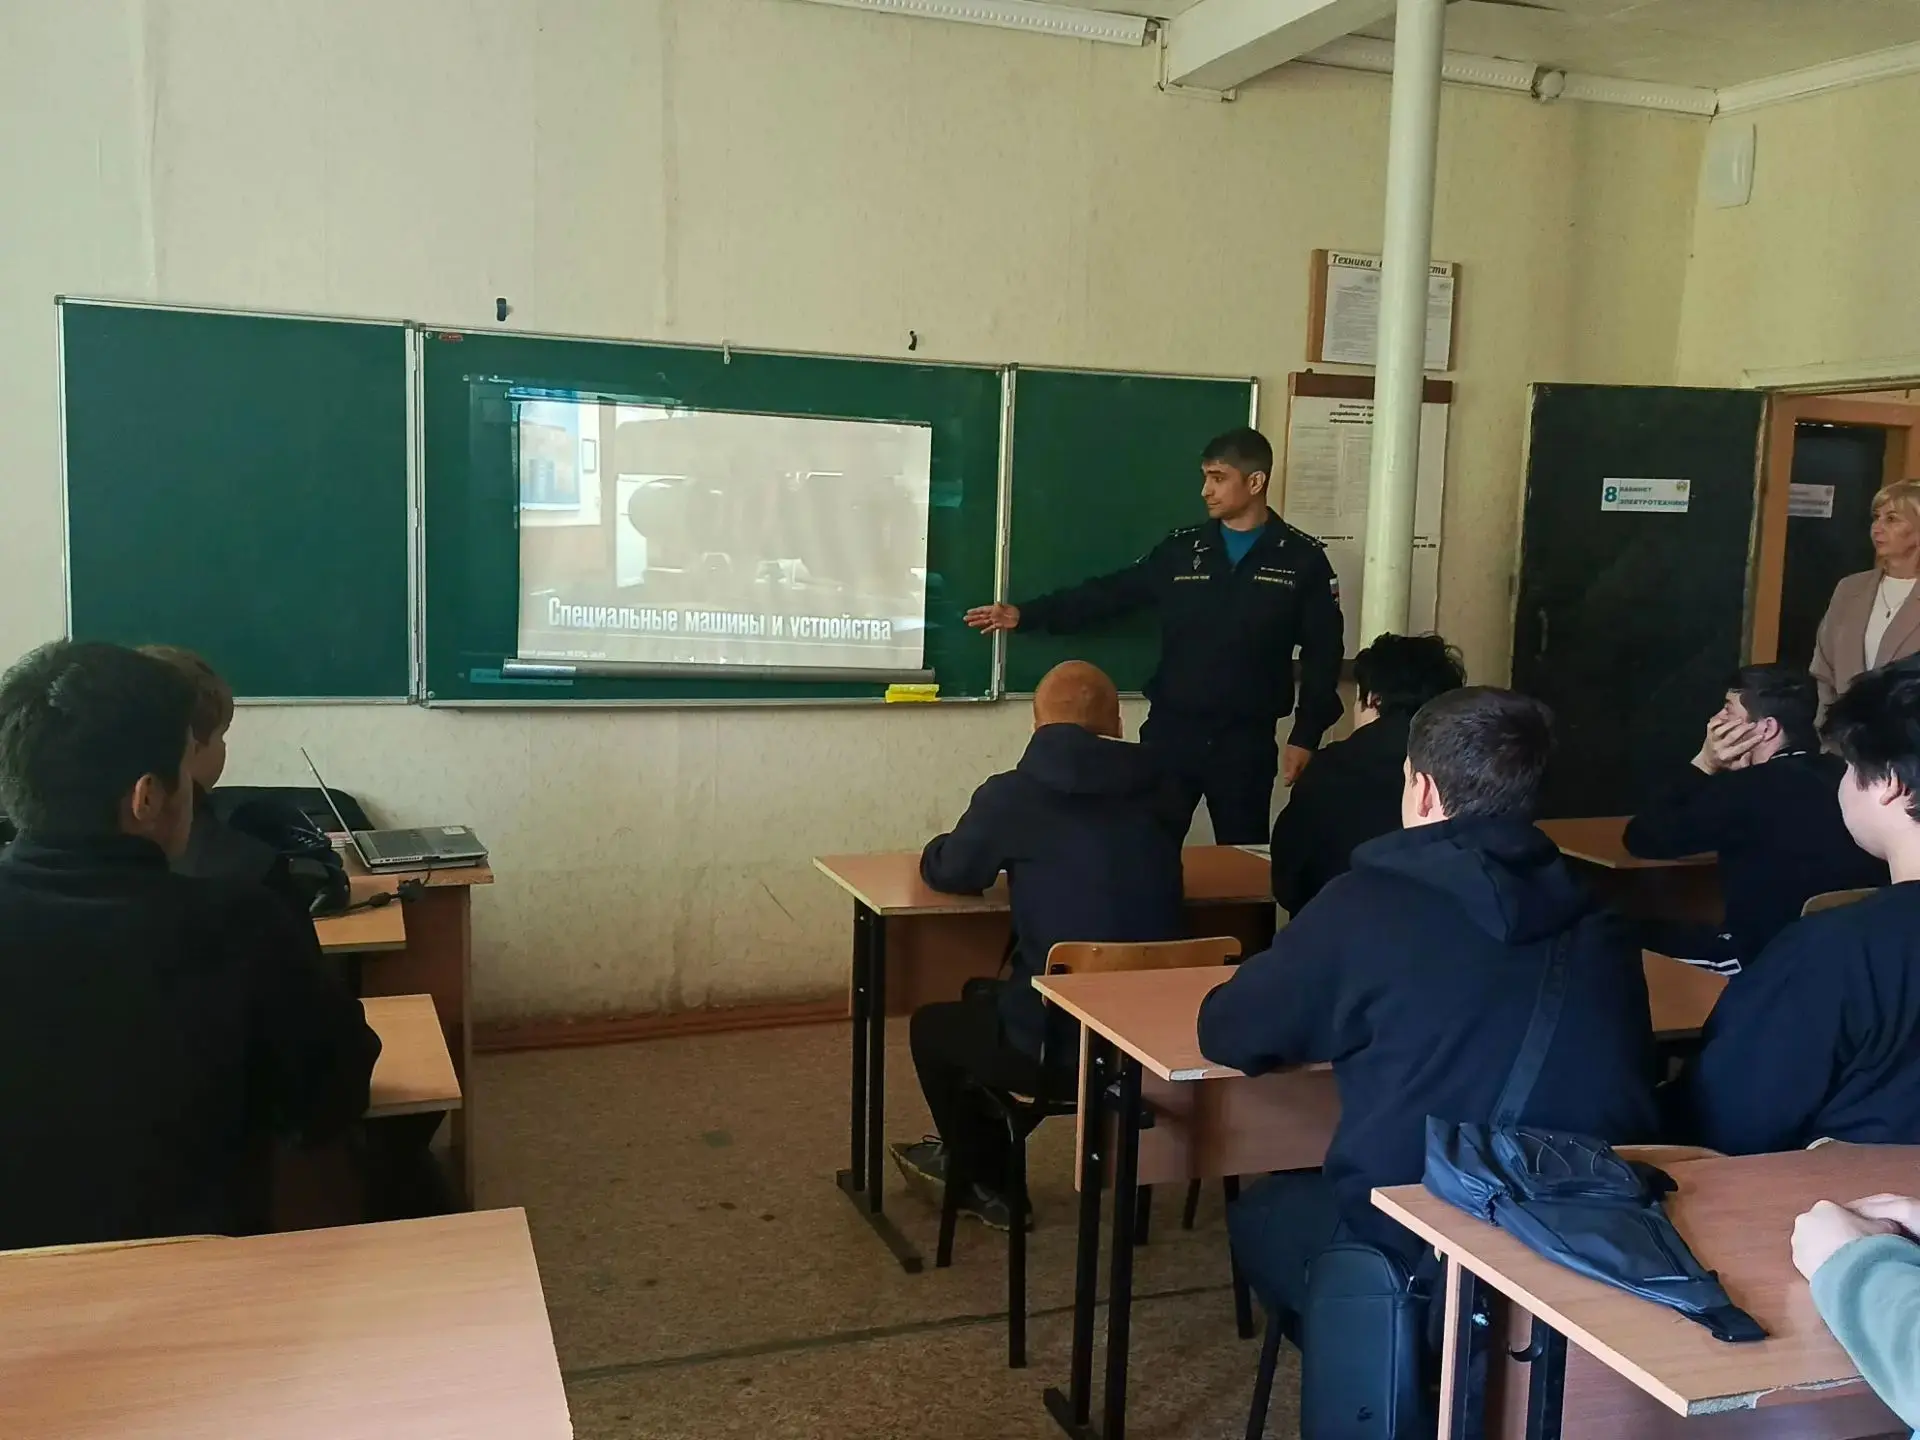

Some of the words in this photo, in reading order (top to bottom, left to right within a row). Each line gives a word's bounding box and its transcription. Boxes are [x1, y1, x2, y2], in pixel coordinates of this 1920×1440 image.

[1332, 253, 1373, 268] Техника
[1604, 486, 1618, 503] 8
[548, 596, 679, 632] Специальные
[685, 609, 765, 636] машины
[771, 614, 784, 637] и
[789, 612, 892, 641] устройства
